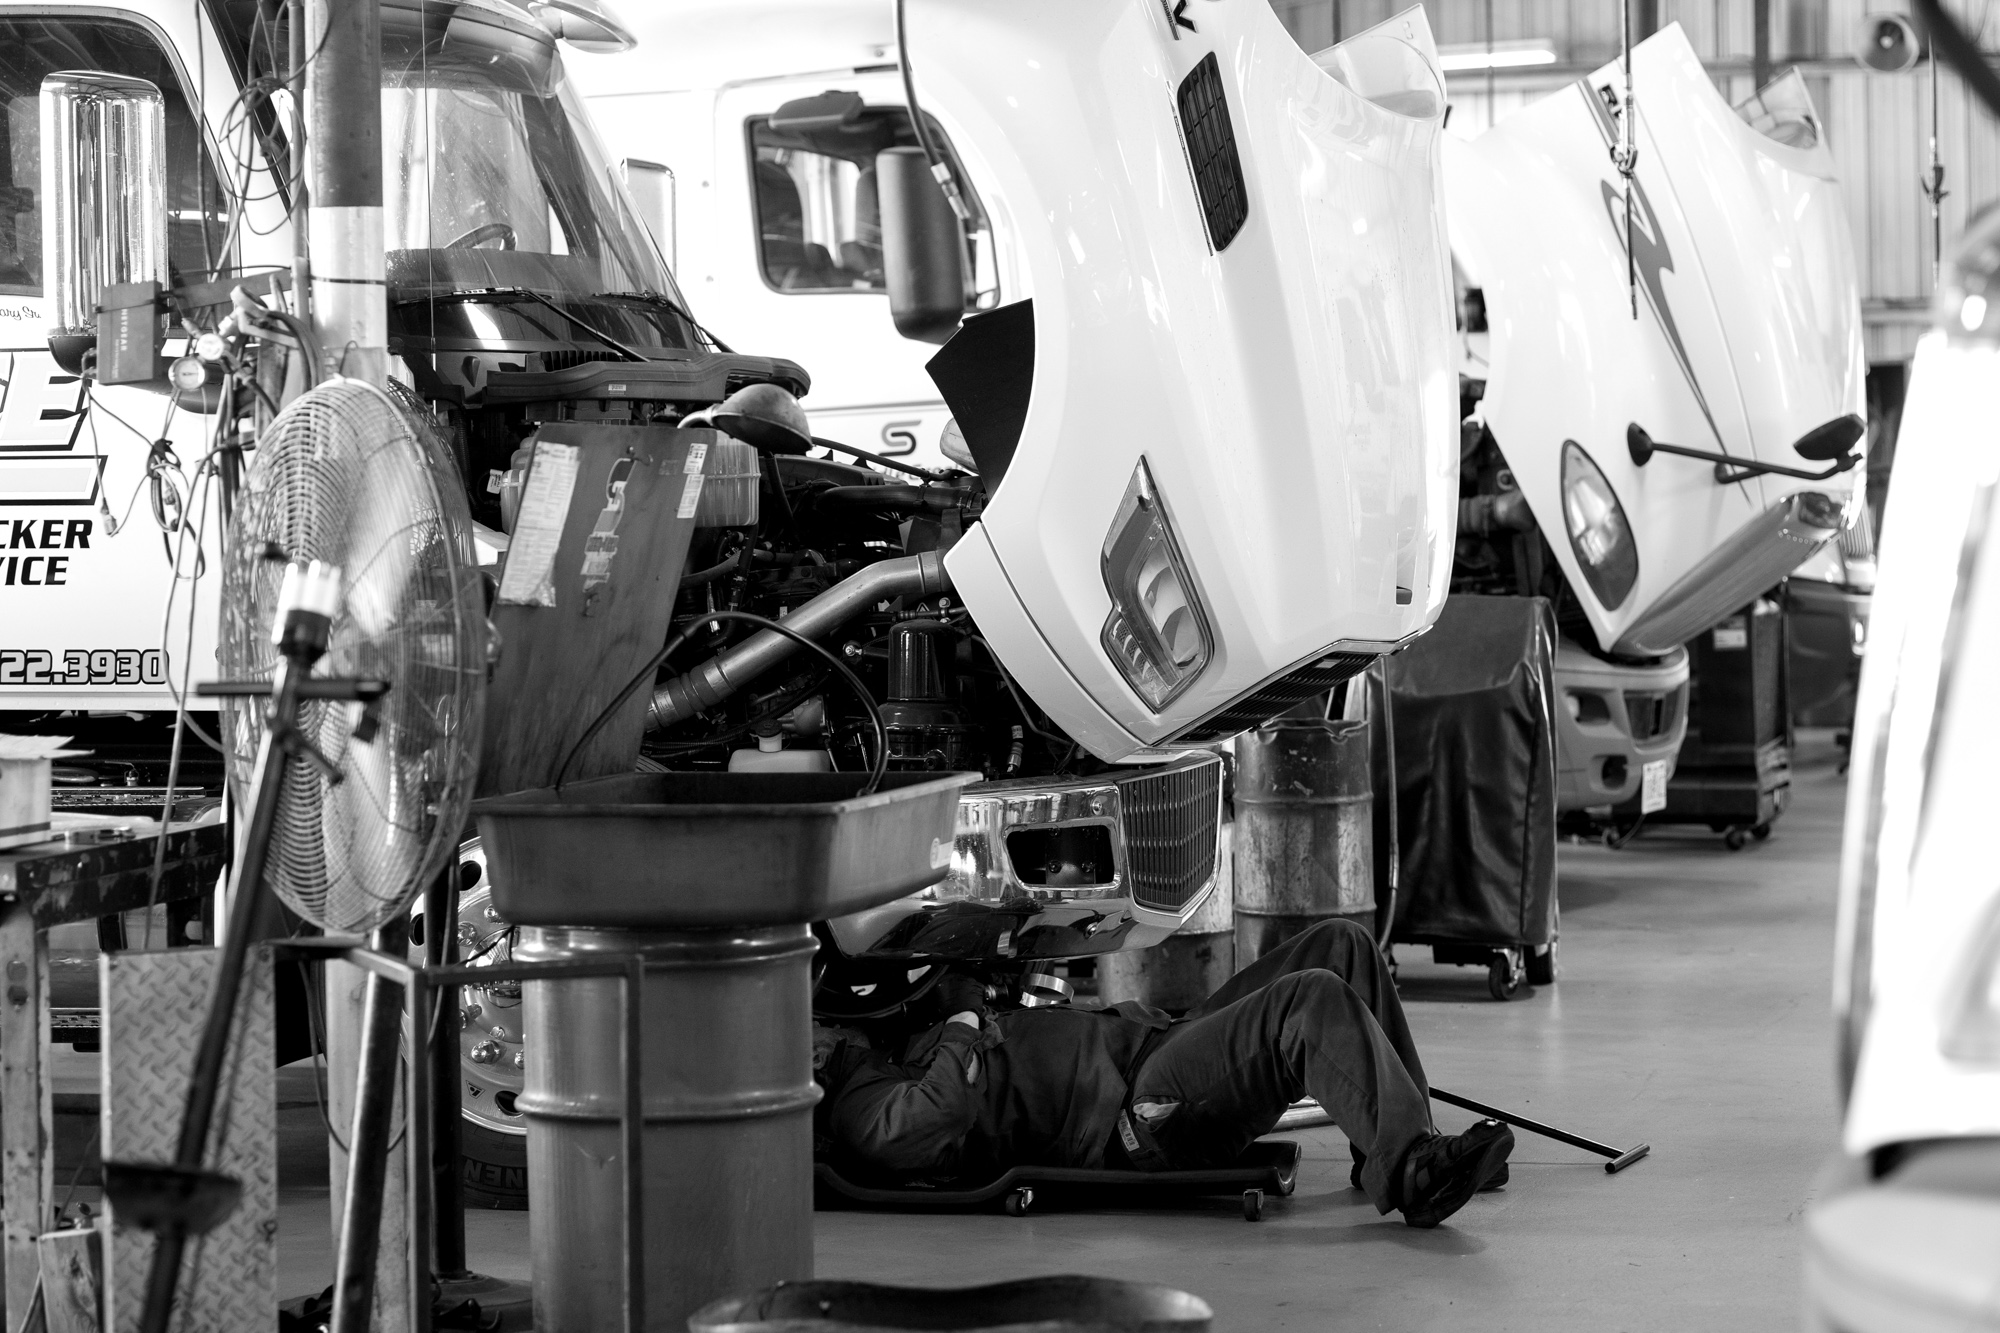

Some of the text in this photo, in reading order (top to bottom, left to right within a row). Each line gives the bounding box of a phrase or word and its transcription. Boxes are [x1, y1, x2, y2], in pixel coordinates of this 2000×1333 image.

[120, 308, 128, 351] NETGEAR
[0, 556, 69, 586] ICE
[0, 649, 169, 685] 22.3930
